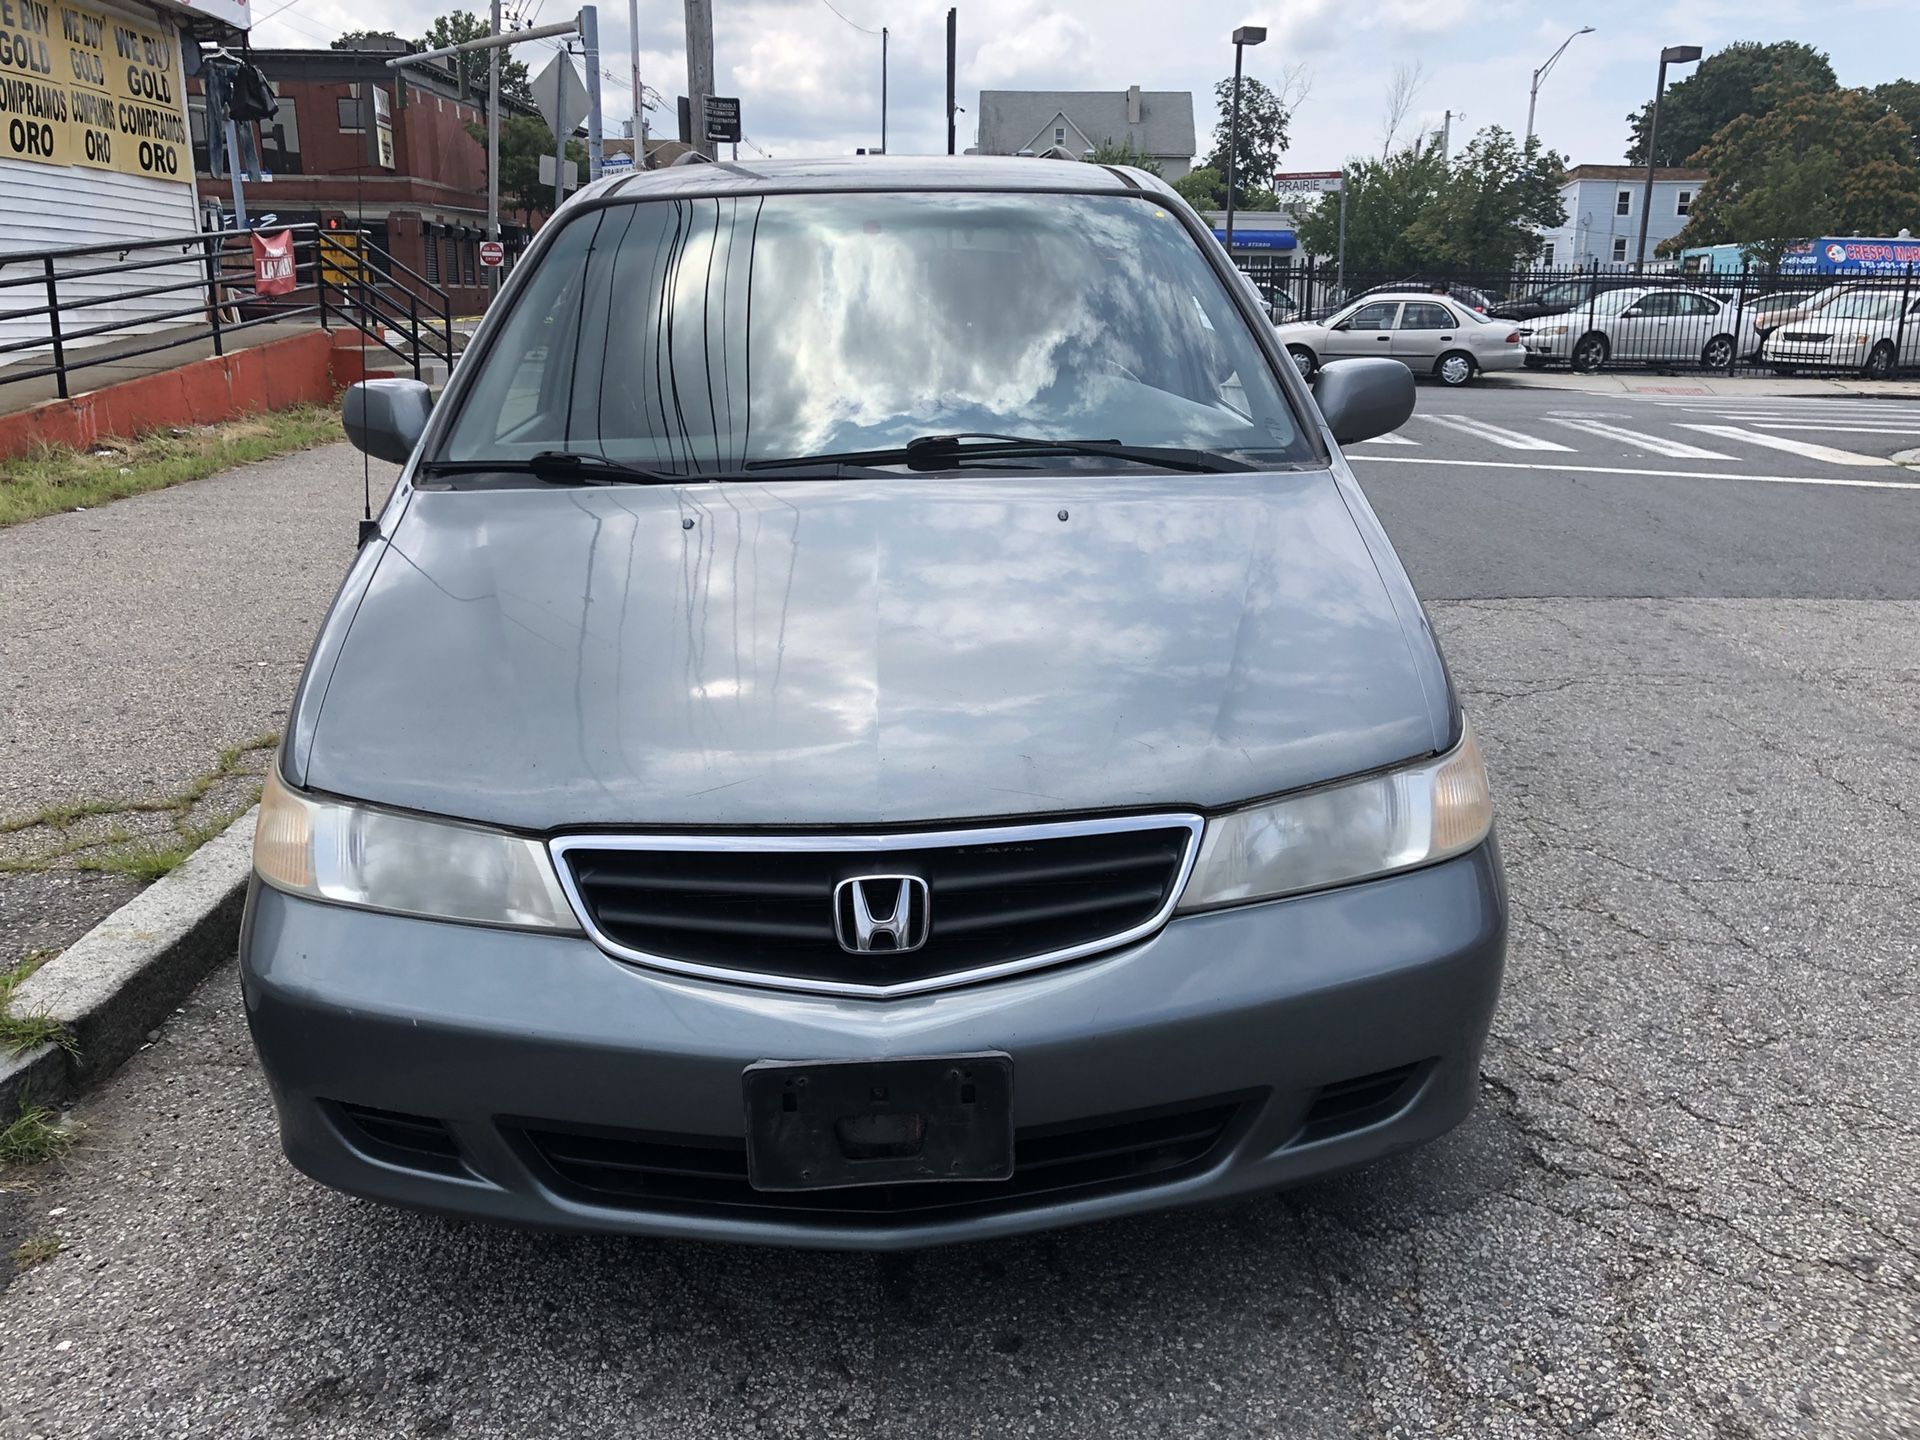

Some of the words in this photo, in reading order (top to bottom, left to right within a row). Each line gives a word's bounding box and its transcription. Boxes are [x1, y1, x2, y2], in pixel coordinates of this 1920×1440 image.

[2, 0, 15, 27] E
[61, 7, 80, 43] WE
[0, 31, 50, 74] GOLD
[113, 25, 141, 62] WE
[70, 47, 104, 86] GOLD
[128, 65, 171, 104] GOLD
[0, 76, 67, 123] OMPRAMOS
[71, 90, 115, 131] COMPRAMOS
[10, 119, 53, 157] ORO
[119, 103, 185, 144] COMPRAMOS
[85, 129, 111, 164] ORO
[139, 141, 177, 175] ORO
[1278, 180, 1320, 191] PRAIRIE
[1845, 244, 1893, 261] CRESPO
[1893, 245, 1920, 261] MAR
